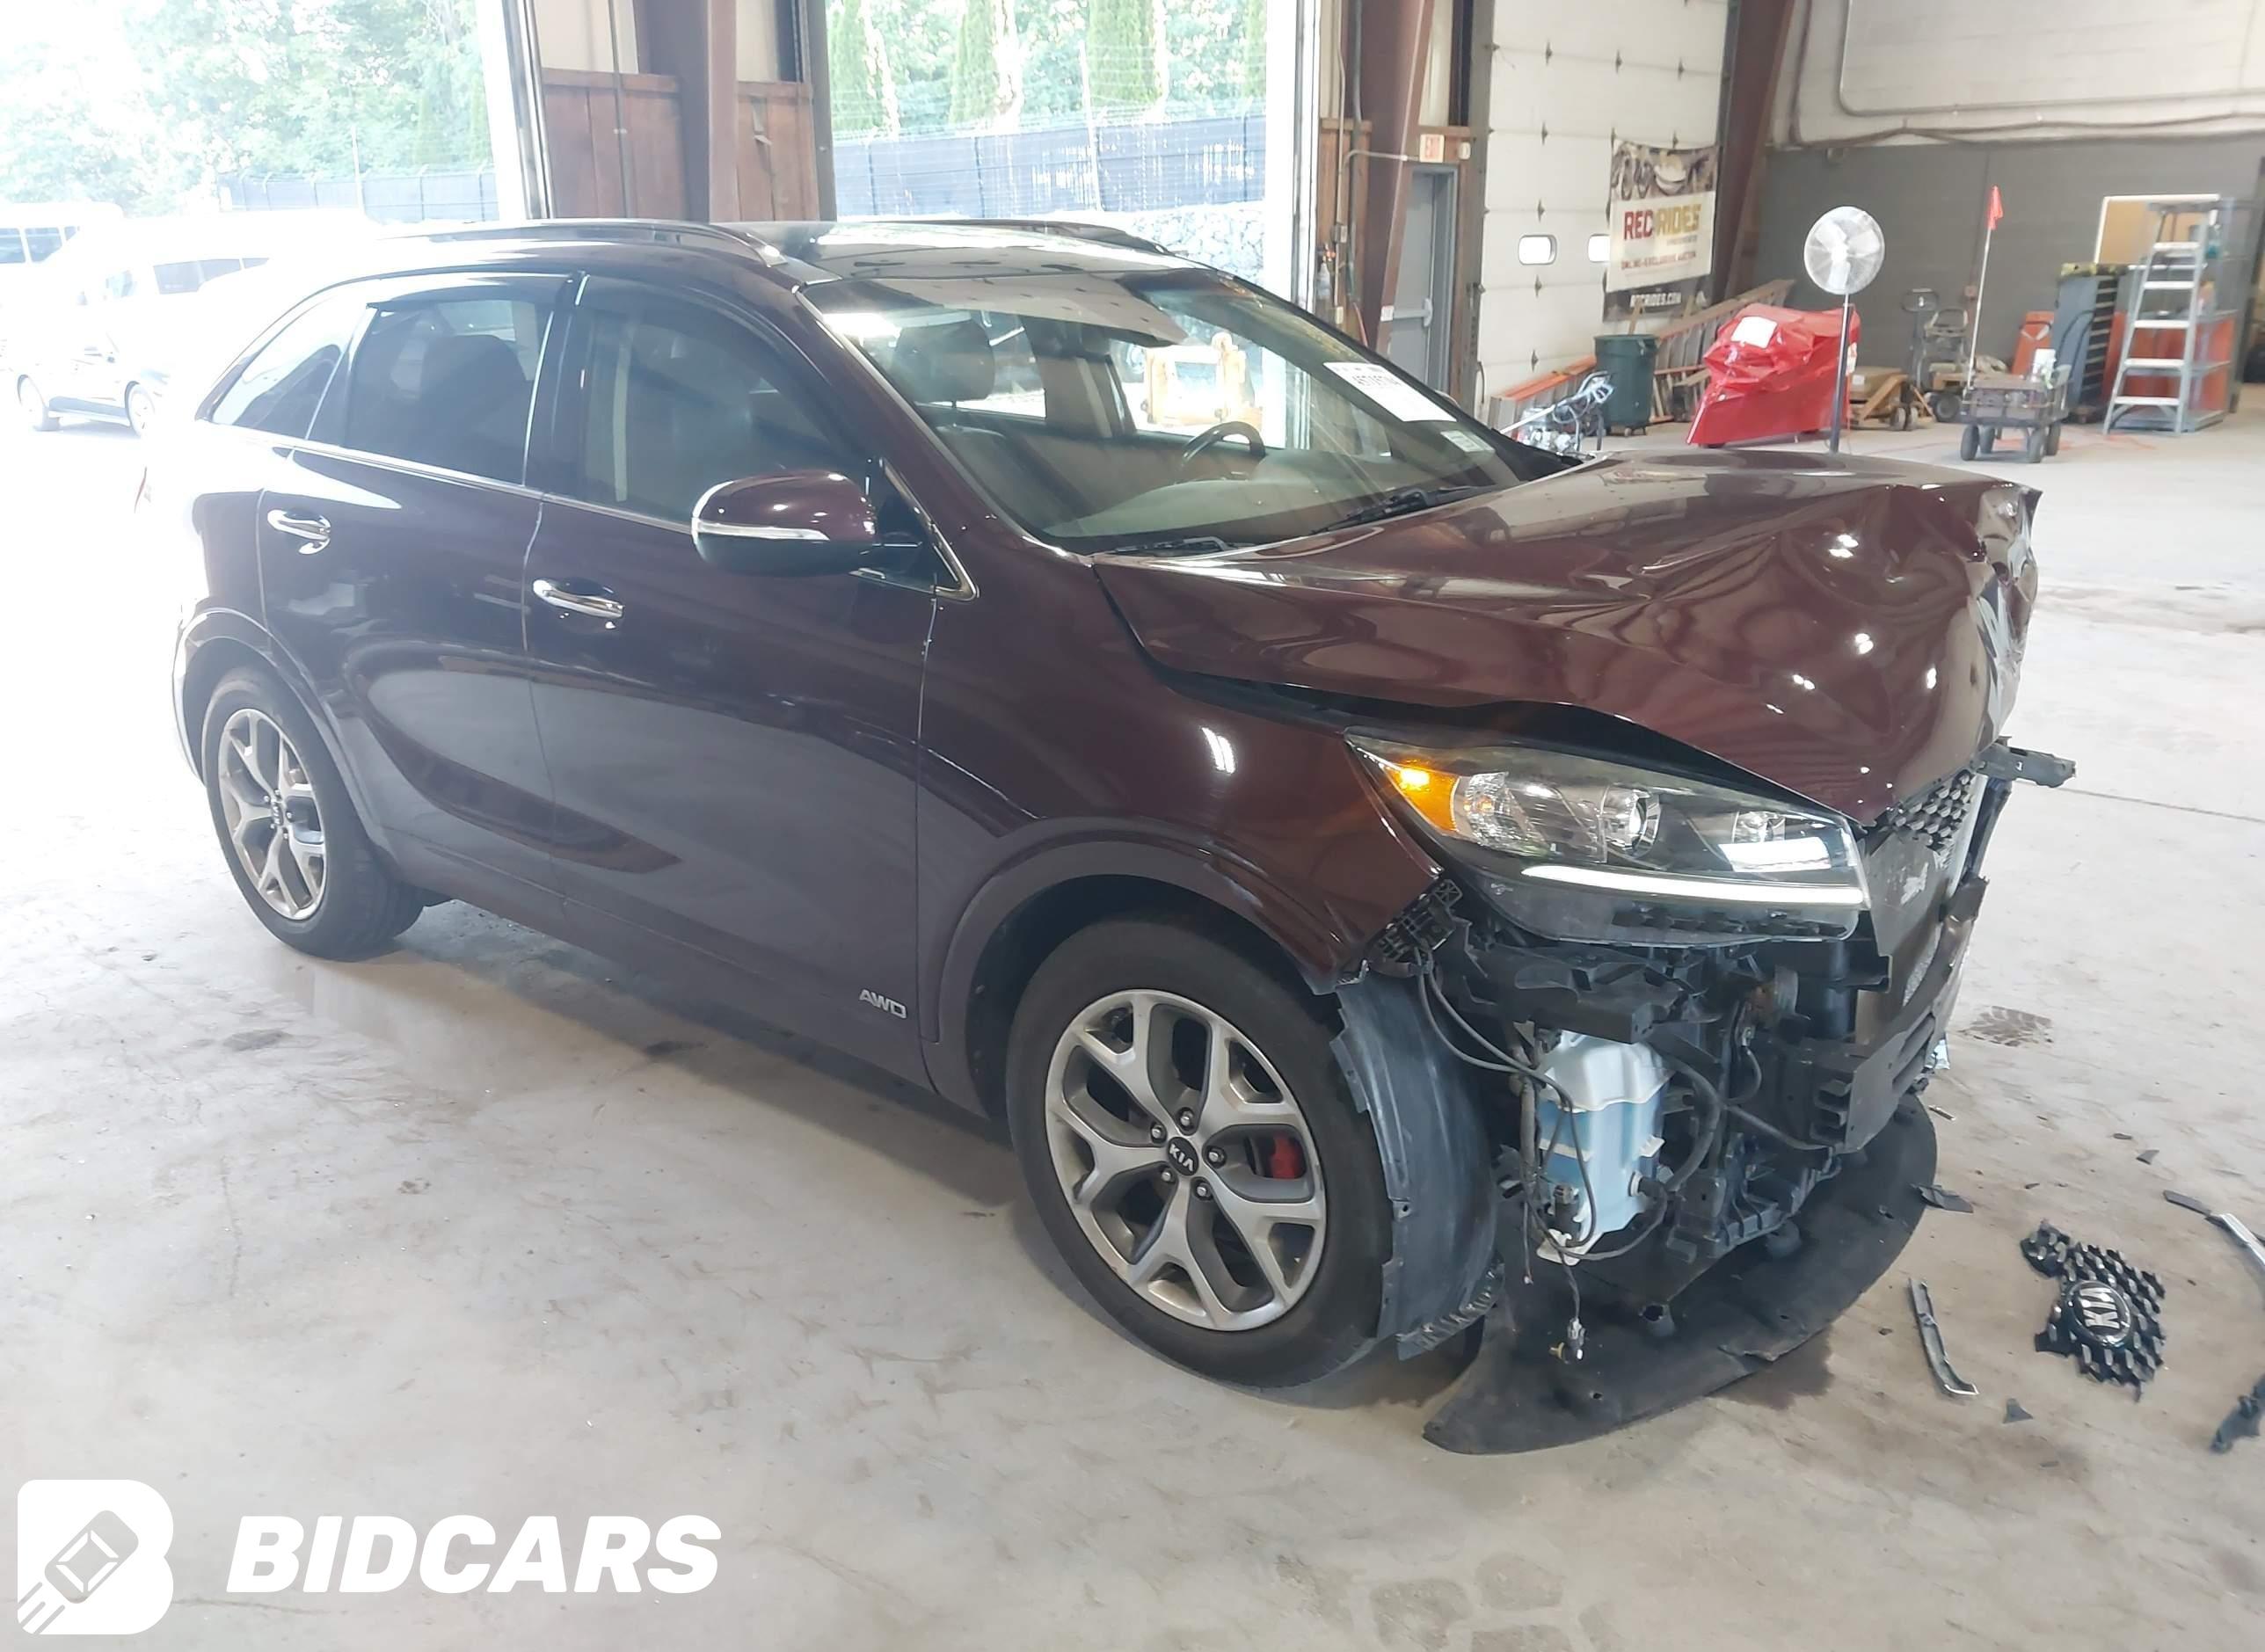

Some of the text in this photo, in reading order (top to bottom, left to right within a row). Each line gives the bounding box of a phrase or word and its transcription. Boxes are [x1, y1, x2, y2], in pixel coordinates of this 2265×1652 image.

[859, 989, 907, 1019] AWD
[1169, 1143, 1194, 1172] KIA
[2078, 1286, 2120, 1329] KIA
